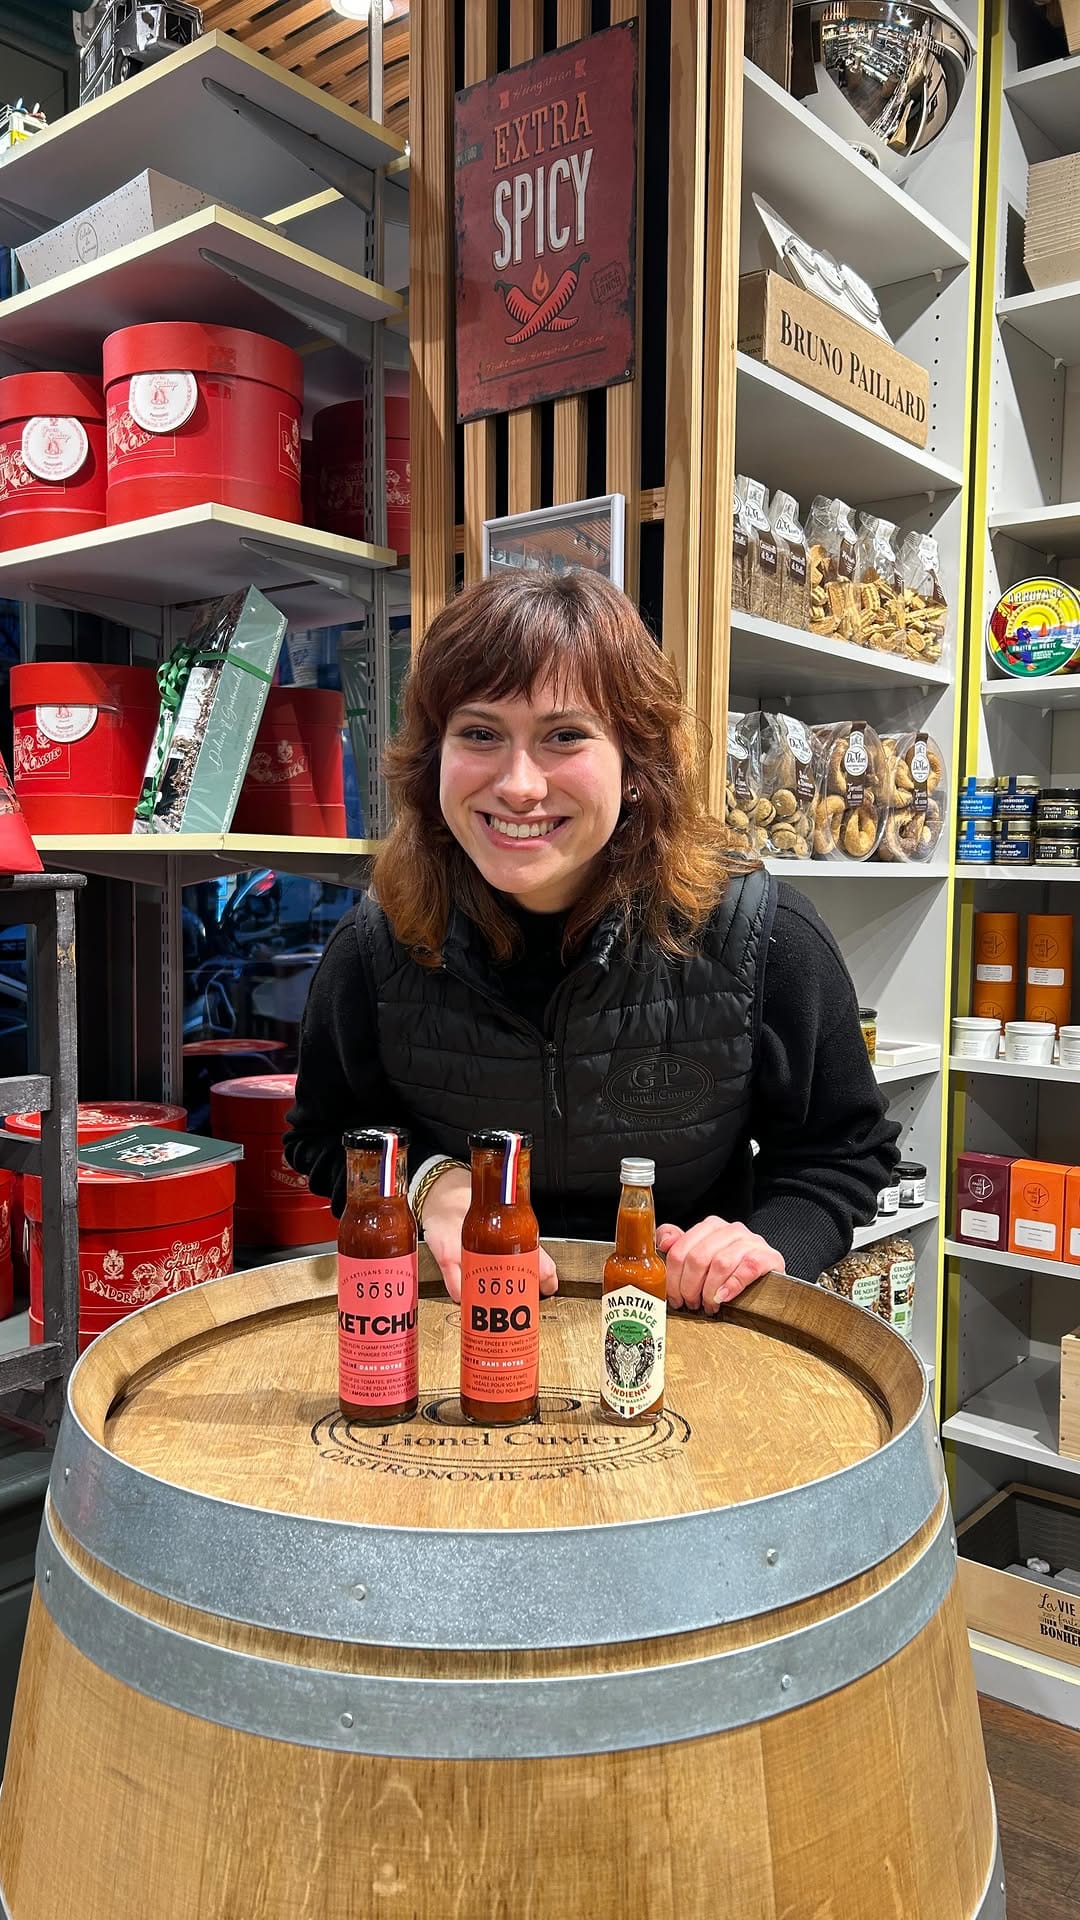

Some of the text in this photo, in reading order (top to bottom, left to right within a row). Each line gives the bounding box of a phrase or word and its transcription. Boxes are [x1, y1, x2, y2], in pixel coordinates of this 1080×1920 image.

[493, 91, 593, 172] EXTRA
[492, 148, 594, 272] SPICY
[780, 309, 927, 424] BRUNO PAILLARD
[172, 1240, 200, 1260] Gran
[350, 1269, 382, 1279] ARTISANS
[472, 1266, 503, 1275] ARTISANS
[356, 1281, 405, 1299] SŌSU
[478, 1278, 526, 1295] SŌSU
[607, 1296, 654, 1312] MARTIN
[471, 1305, 531, 1333] BBQ
[605, 1308, 657, 1329] HOT SAUCE
[657, 1342, 662, 1352] 5
[380, 1362, 402, 1370] NOTRE
[472, 1373, 512, 1381] NATURELLEMENT
[606, 1379, 652, 1398] L'INDIENNE
[377, 1431, 628, 1447] Lionel Cuvier
[319, 1448, 525, 1482] GASTRONOMIE
[1038, 1593, 1076, 1617] La VIE
